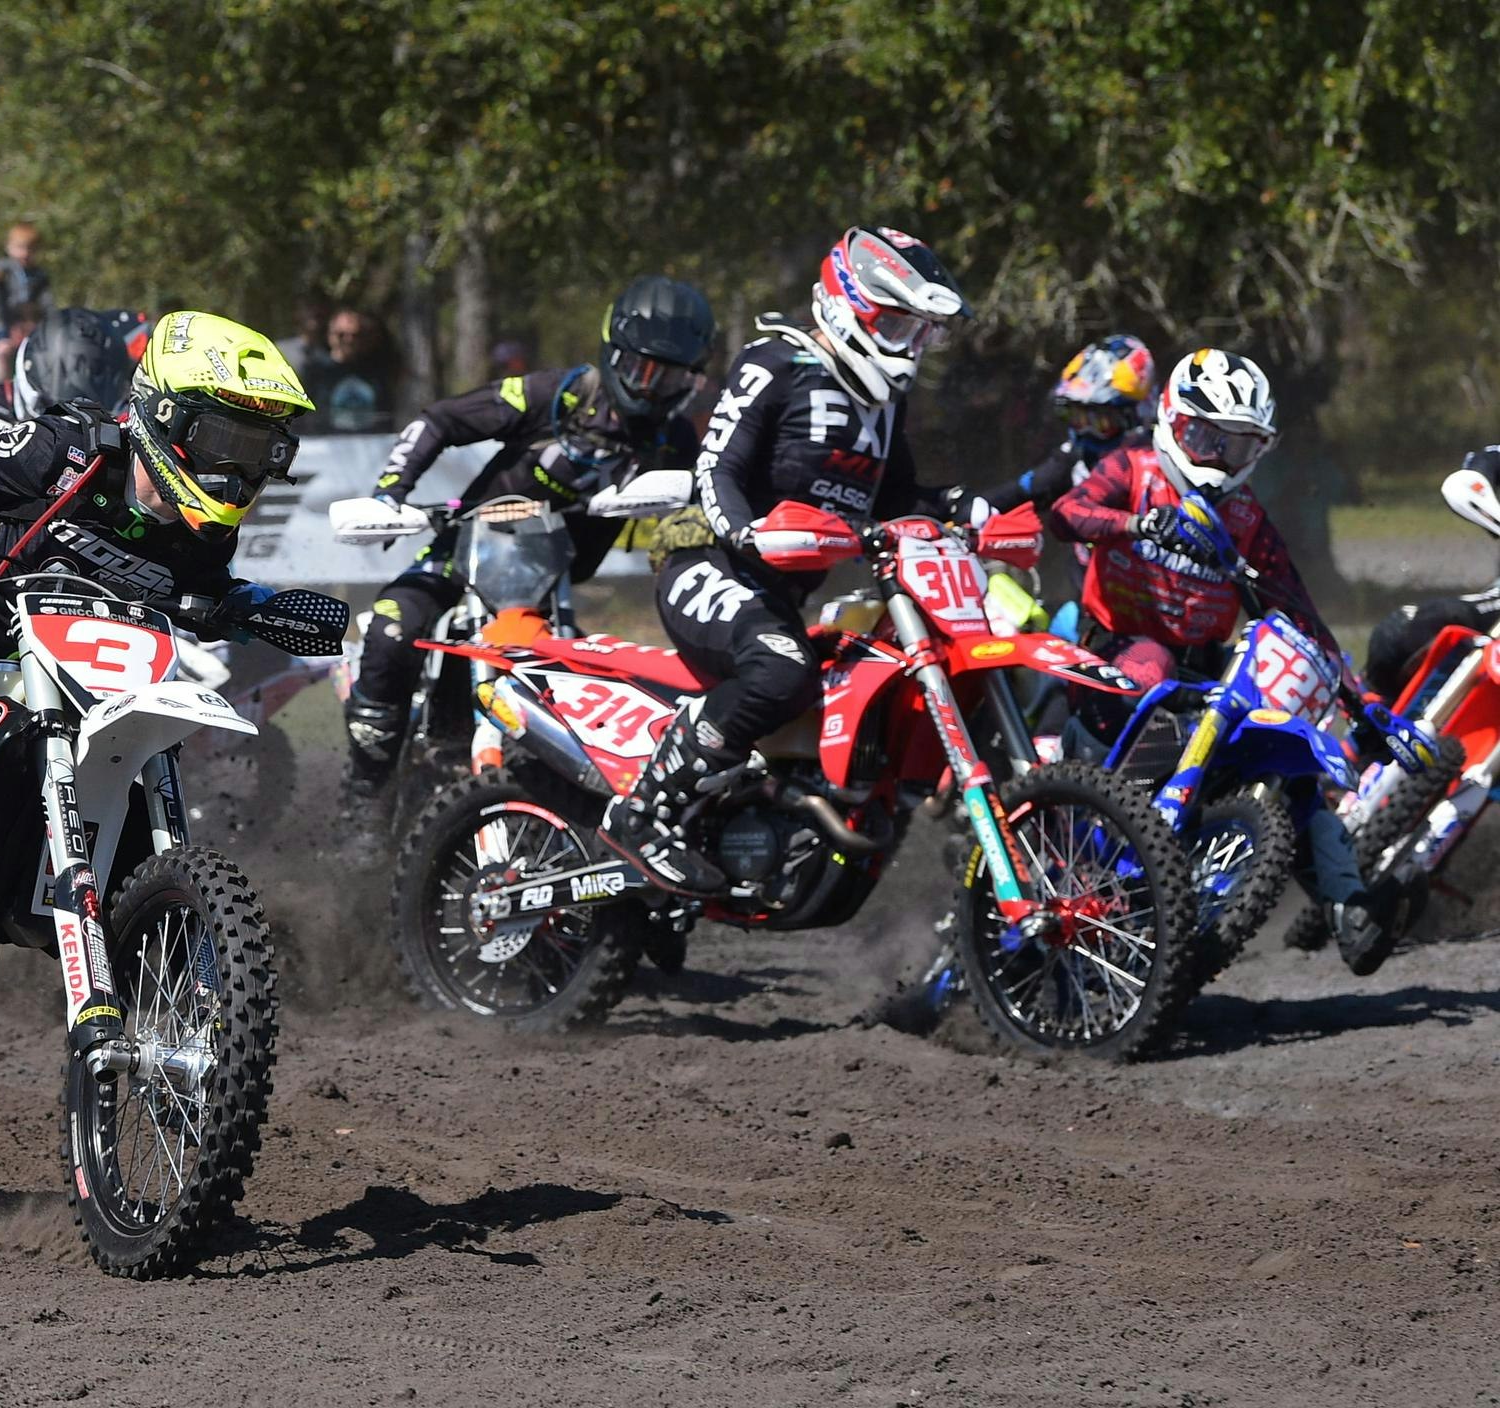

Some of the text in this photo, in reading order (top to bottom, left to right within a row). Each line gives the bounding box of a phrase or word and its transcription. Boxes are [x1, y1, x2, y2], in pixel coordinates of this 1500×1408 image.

[667, 560, 755, 624] FXR
[915, 559, 979, 609] 314
[248, 613, 321, 634] ACERBIS
[59, 619, 158, 693] 3
[555, 683, 655, 748] 314
[60, 923, 85, 1006] KENDA
